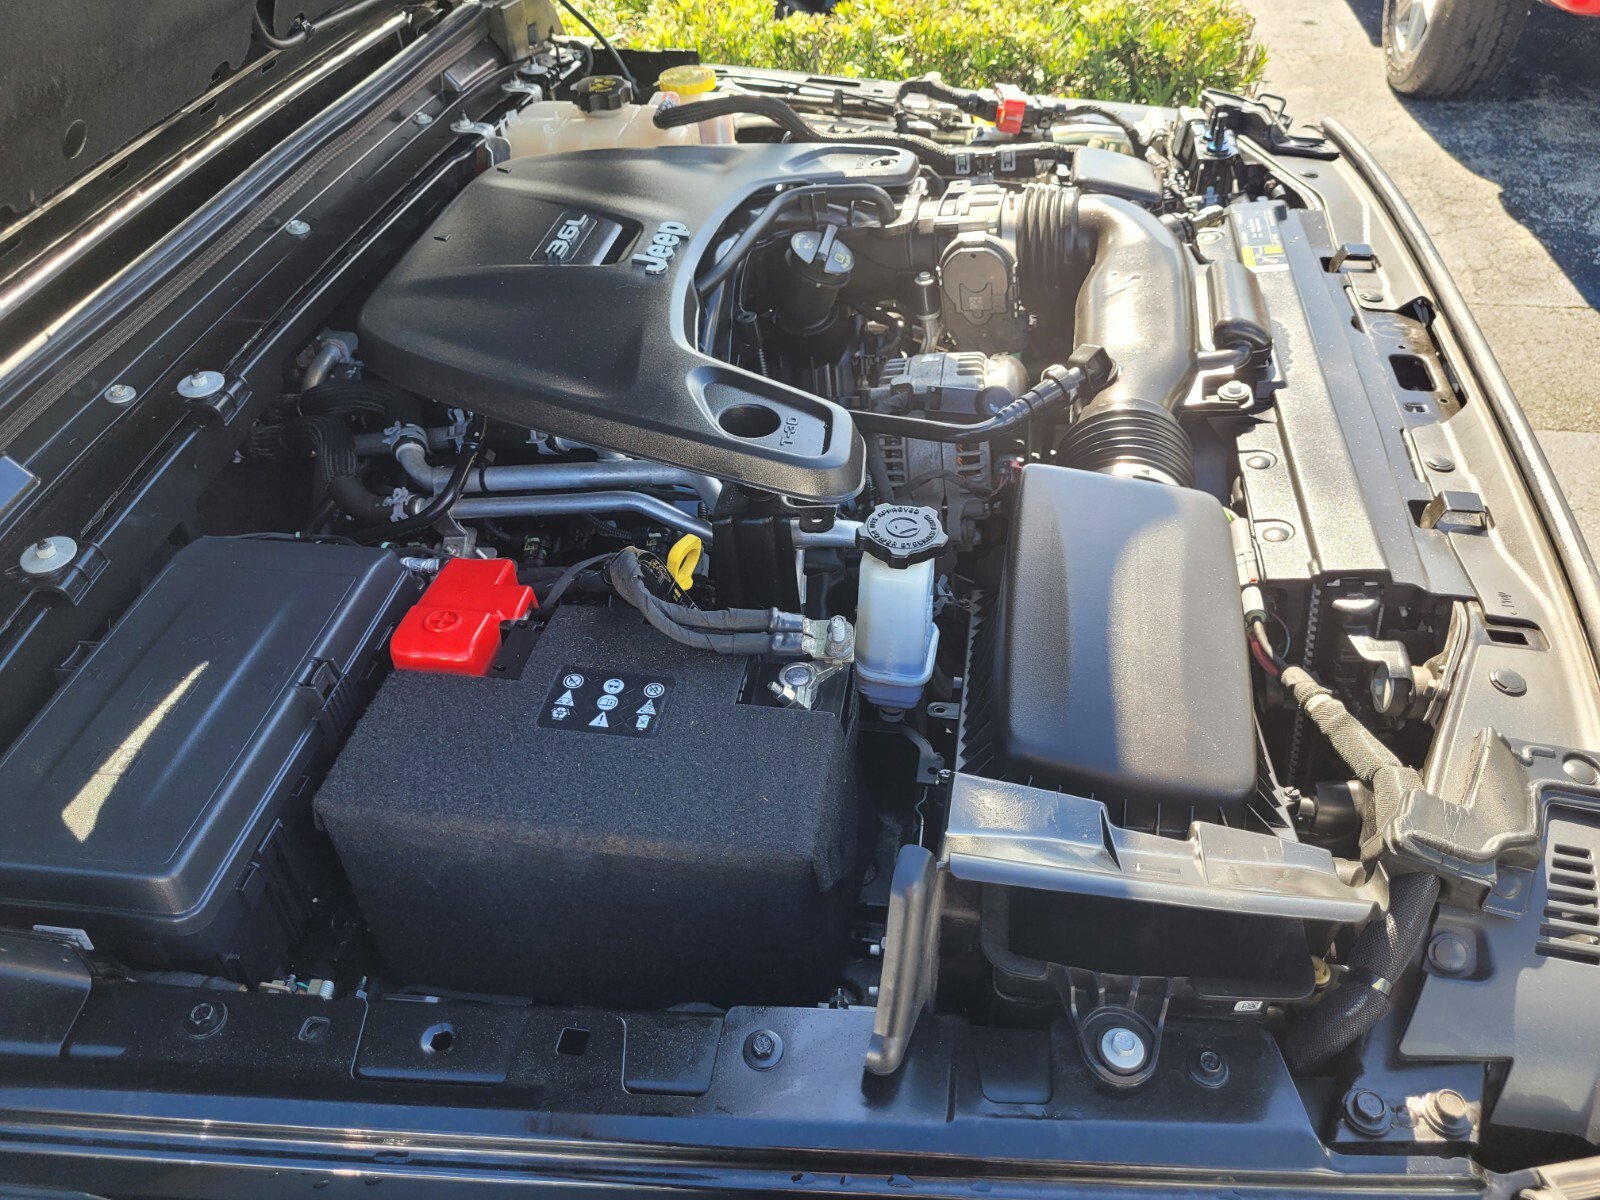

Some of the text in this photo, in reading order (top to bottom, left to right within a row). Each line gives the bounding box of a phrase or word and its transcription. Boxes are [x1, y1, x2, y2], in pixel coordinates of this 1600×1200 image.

[632, 221, 692, 275] Jeep
[877, 506, 920, 518] APPROVED
[870, 530, 898, 548] POWER
